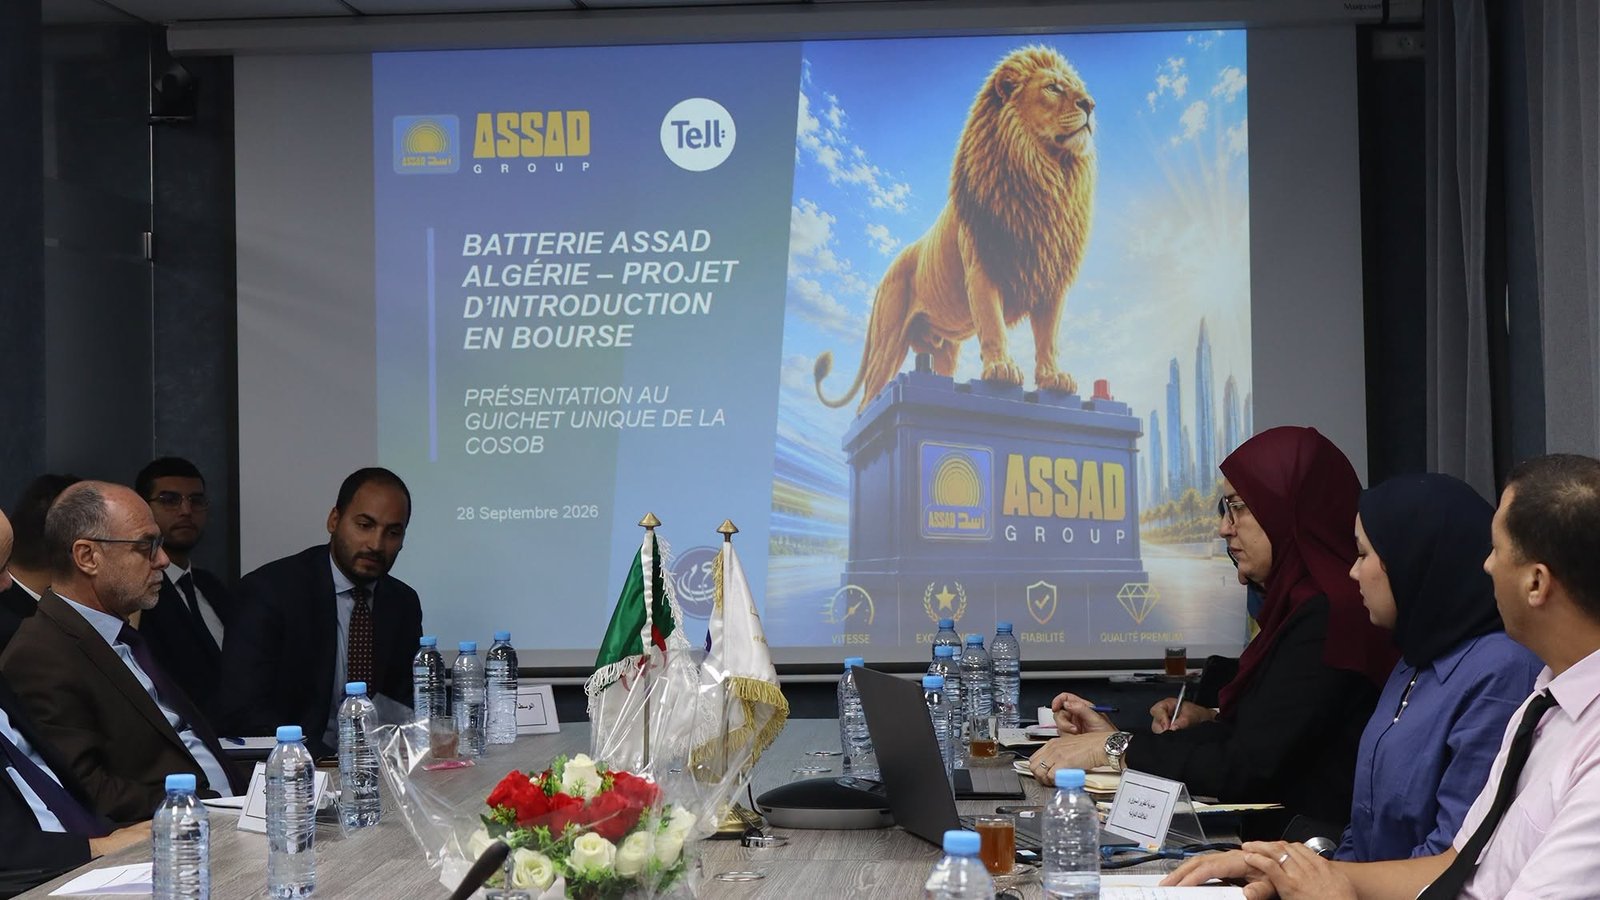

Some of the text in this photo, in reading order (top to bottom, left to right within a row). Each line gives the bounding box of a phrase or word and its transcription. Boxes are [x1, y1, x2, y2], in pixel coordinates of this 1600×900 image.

[473, 110, 591, 158] ASSAD
[462, 229, 711, 256] BATTERIE ASSAD
[461, 259, 591, 288] ALGÉRIE
[622, 260, 739, 284] PROJET
[463, 325, 634, 350] EN BOURSE
[464, 385, 669, 407] PRÉSENTATION AU
[465, 409, 726, 430] GUICHET UNIQUE DE LA
[465, 436, 544, 455] COSOB
[1003, 453, 1126, 521] ASSAD
[457, 505, 599, 522] 28 Septembre 2026
[928, 511, 956, 529] ASSAD
[1004, 525, 1126, 545] GROUP
[831, 634, 870, 644] VITESSE
[1021, 631, 1065, 643] FIABILITÉ
[1101, 631, 1184, 642] QUALITÉ PREMIUM
